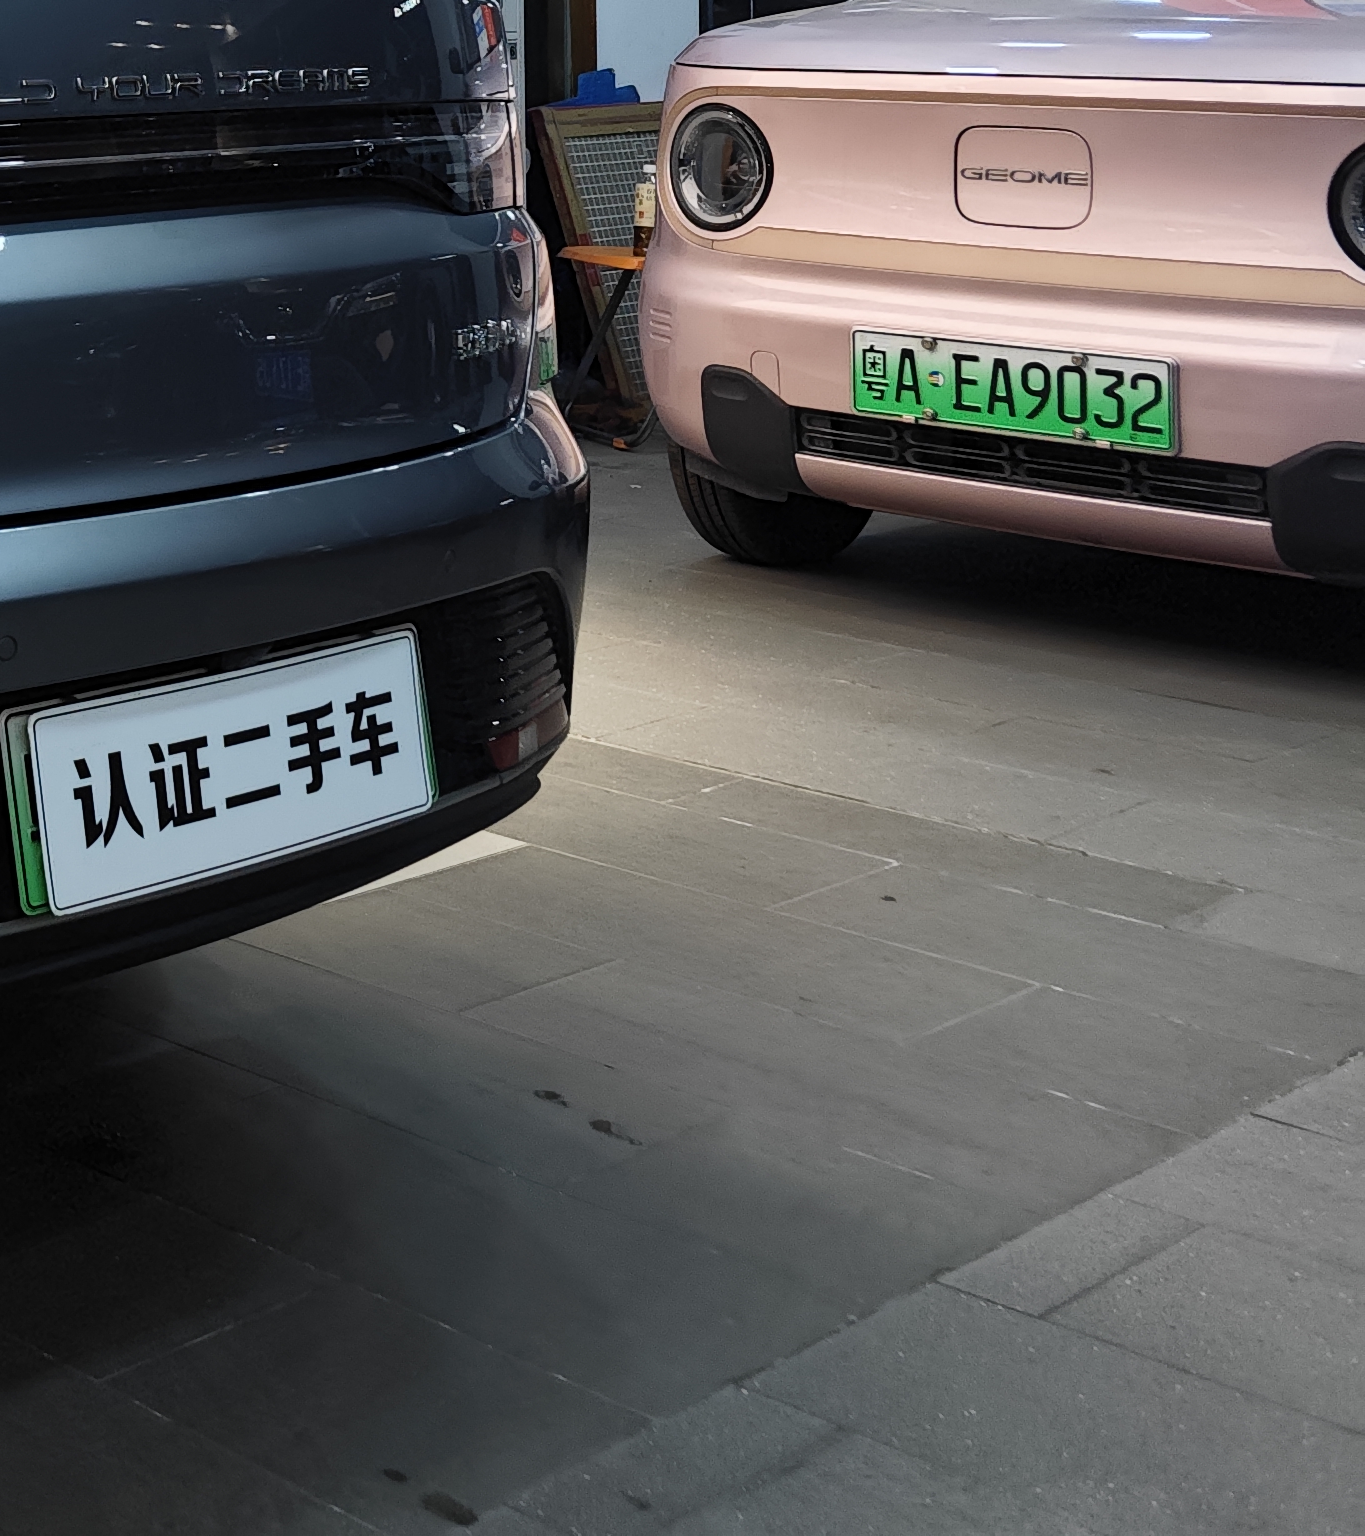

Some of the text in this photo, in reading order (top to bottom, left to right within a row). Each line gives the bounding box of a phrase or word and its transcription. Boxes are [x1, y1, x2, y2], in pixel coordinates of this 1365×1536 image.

[76, 72, 204, 101] YOUR
[219, 67, 370, 96] DREAMS
[960, 166, 1089, 186] GEOME
[73, 691, 399, 849] 认证二手车
